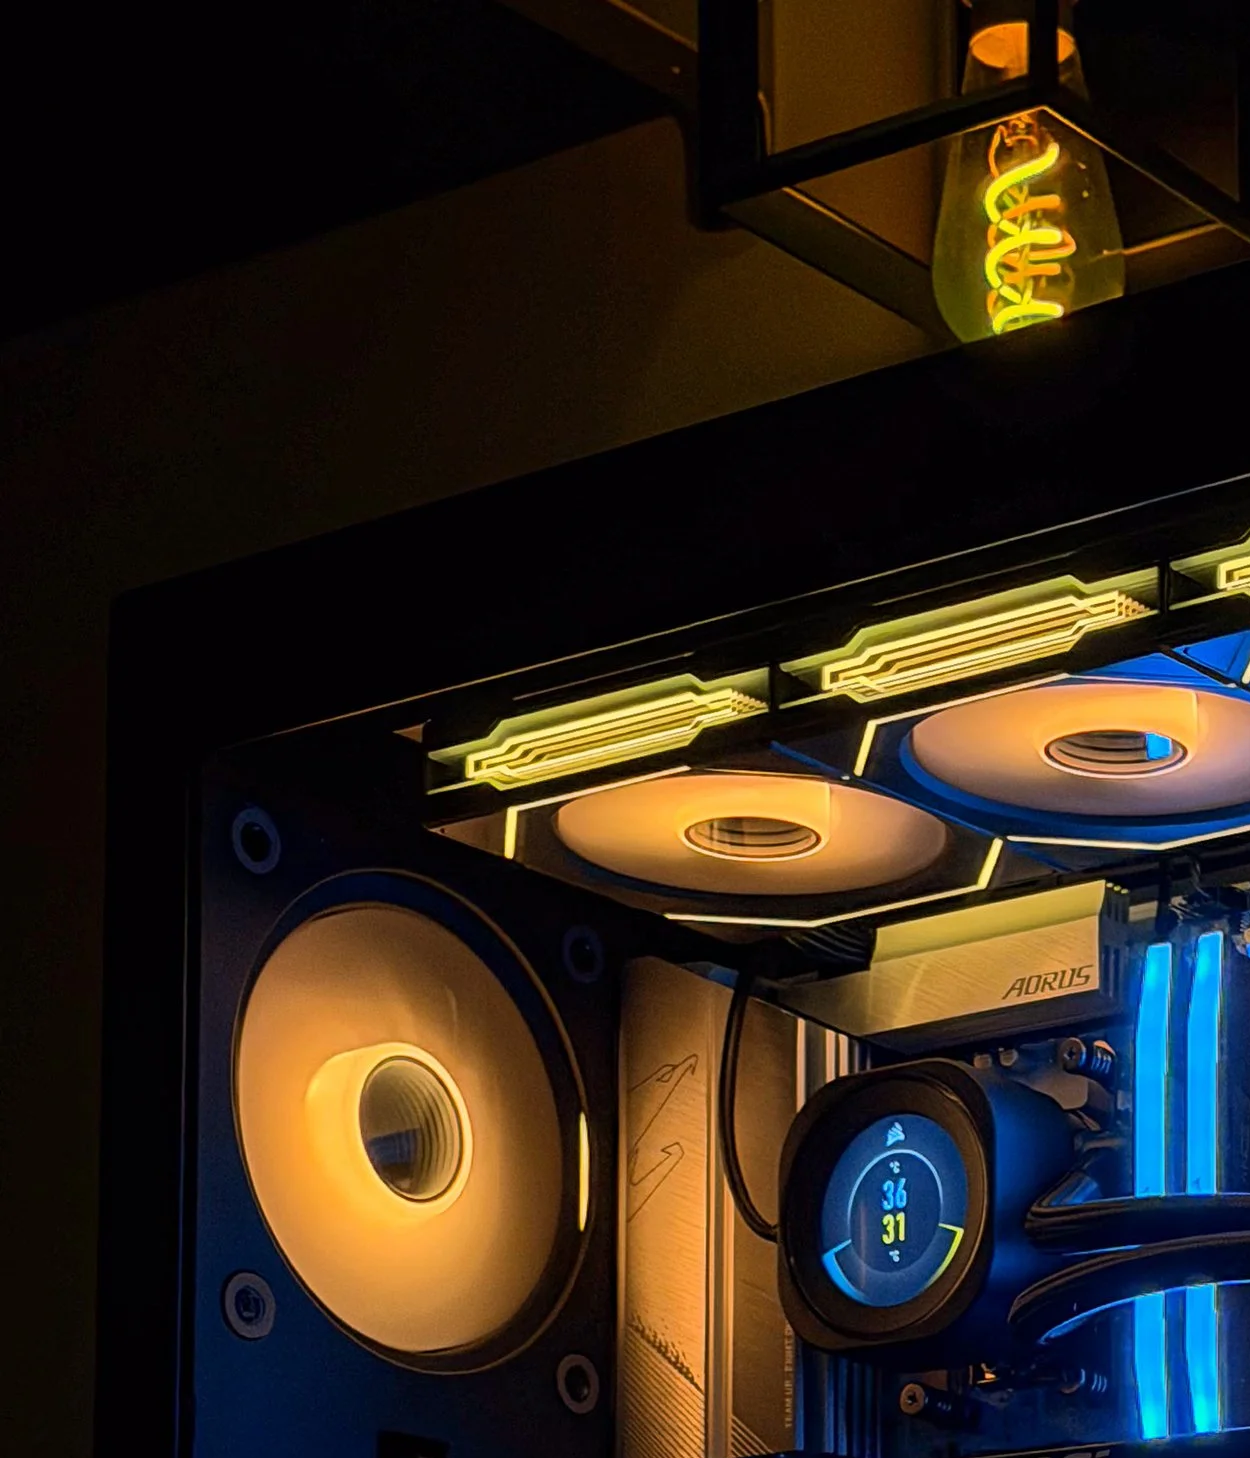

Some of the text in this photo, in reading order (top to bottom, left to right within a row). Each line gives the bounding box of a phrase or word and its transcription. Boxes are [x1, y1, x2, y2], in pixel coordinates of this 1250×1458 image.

[1001, 964, 1094, 1000] AORUS
[881, 1177, 907, 1211] 36
[881, 1211, 906, 1245] 31
